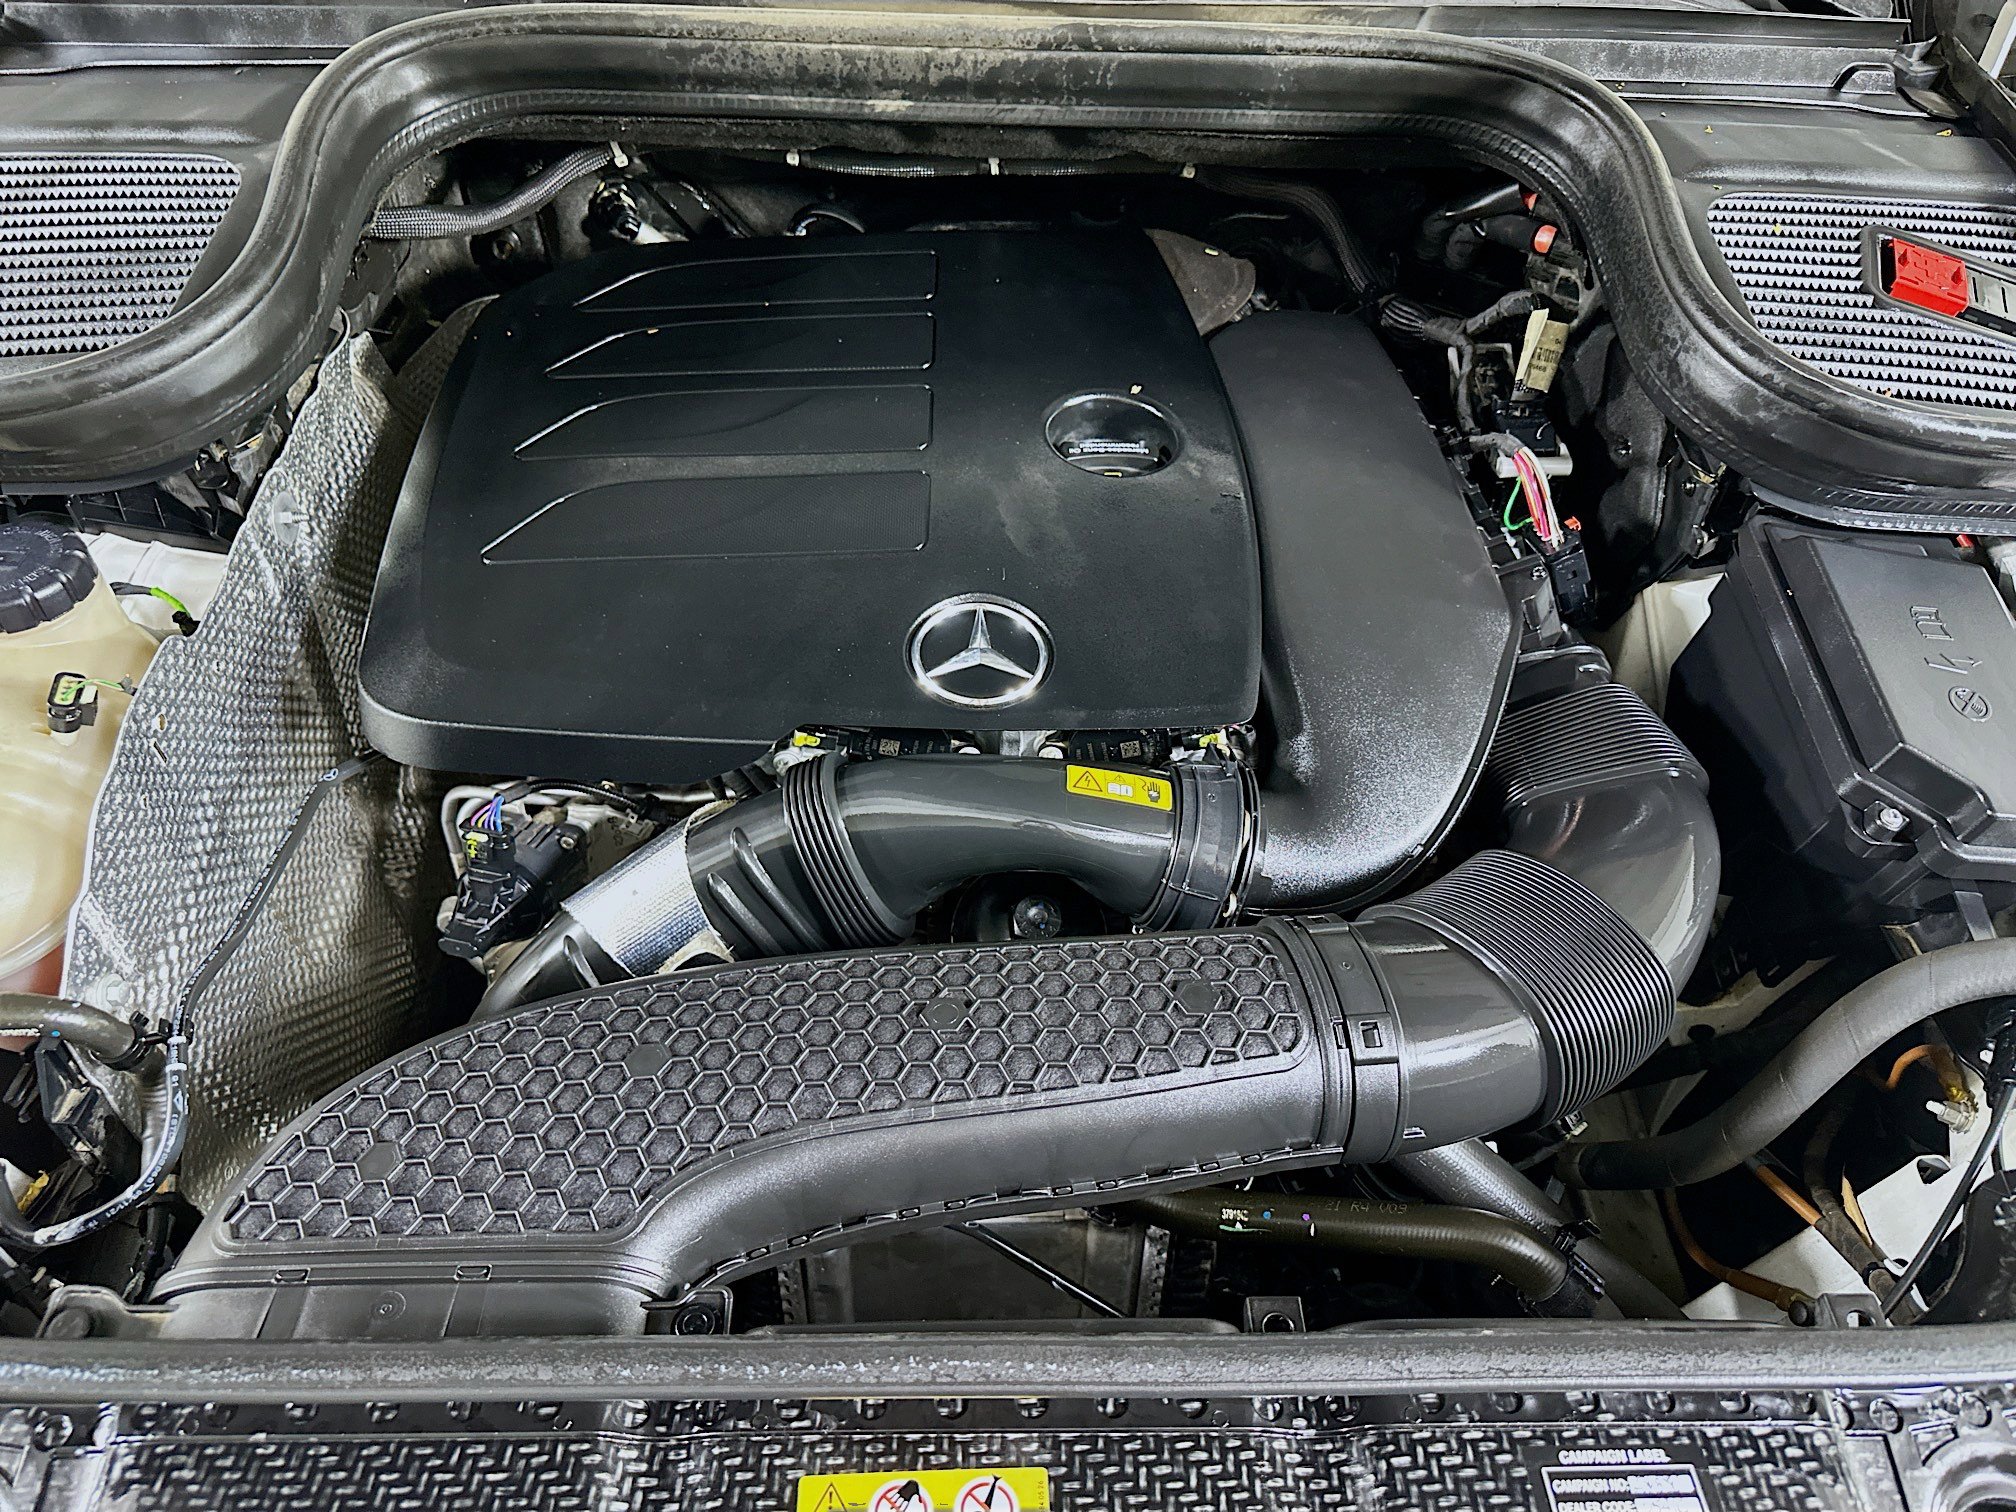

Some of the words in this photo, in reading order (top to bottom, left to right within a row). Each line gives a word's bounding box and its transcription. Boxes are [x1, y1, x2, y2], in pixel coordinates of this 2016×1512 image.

[1558, 1449, 1628, 1465] CAMPAIGN
[1628, 1448, 1671, 1464] LABEL
[1552, 1478, 1609, 1494] CAMPAIGN
